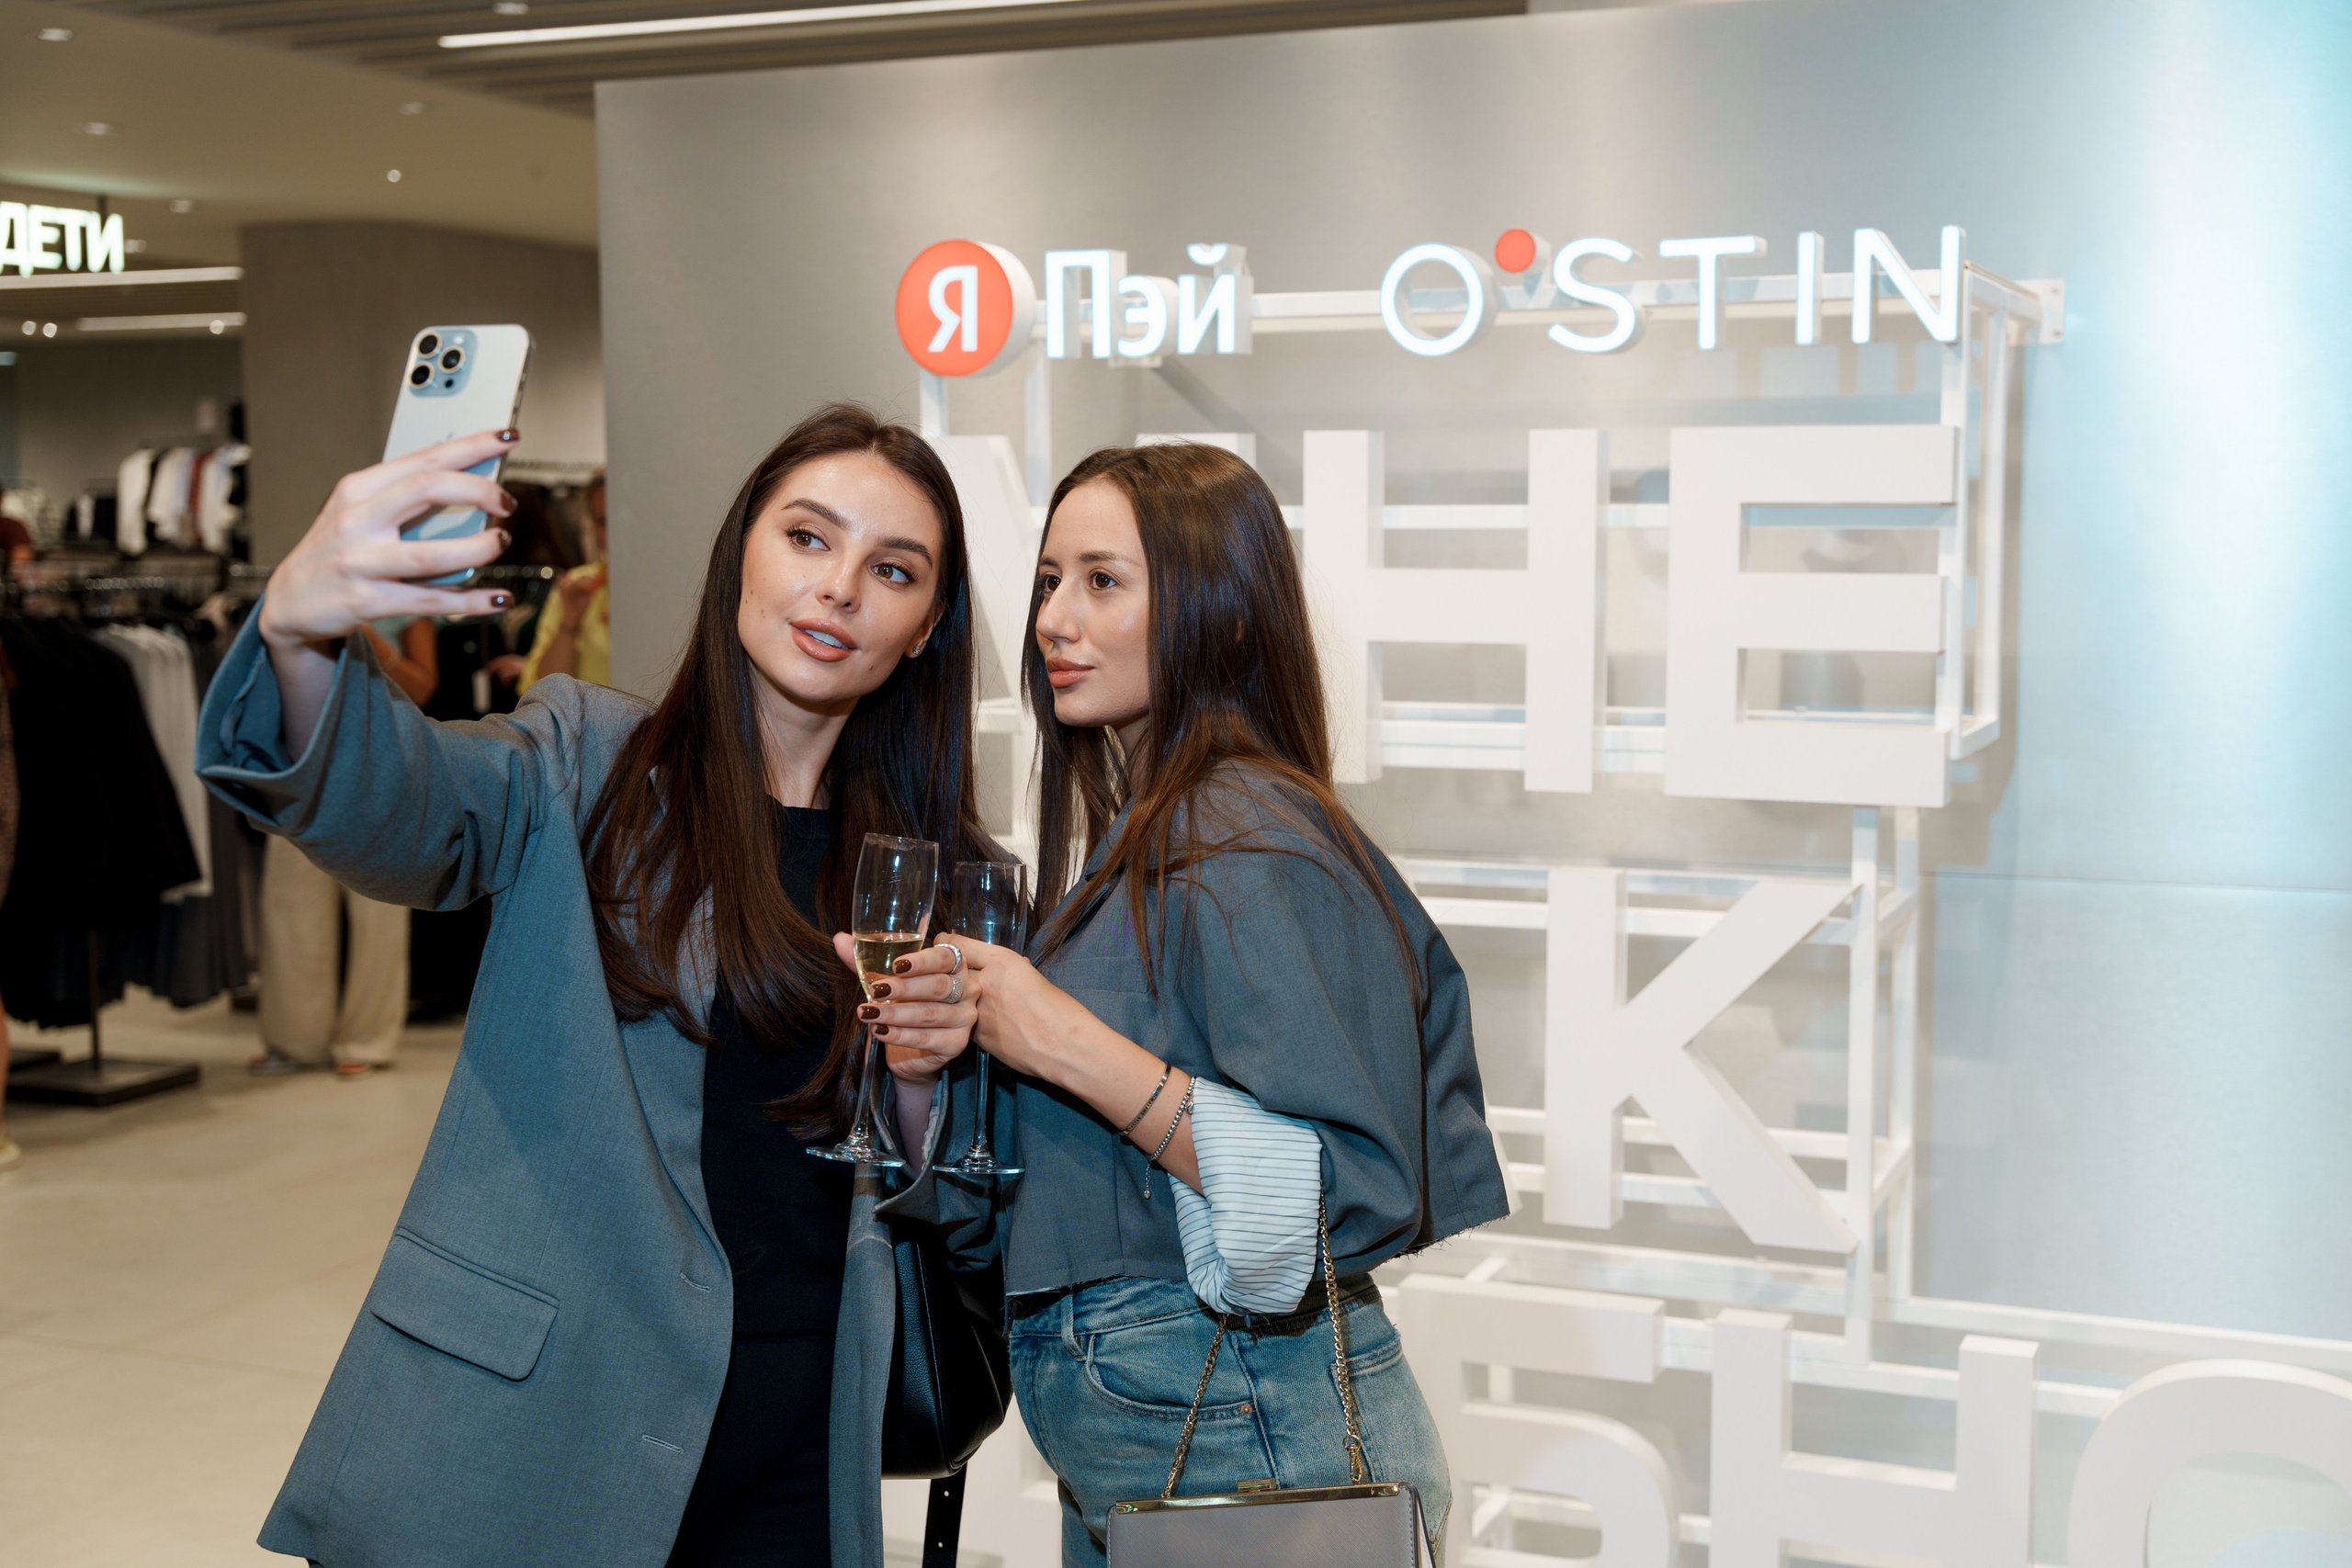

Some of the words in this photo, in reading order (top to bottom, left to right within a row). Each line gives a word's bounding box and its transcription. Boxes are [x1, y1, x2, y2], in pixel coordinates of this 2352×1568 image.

[0, 199, 125, 278] ДЕТИ
[927, 265, 979, 353] Я
[1045, 243, 1237, 359] Пэй
